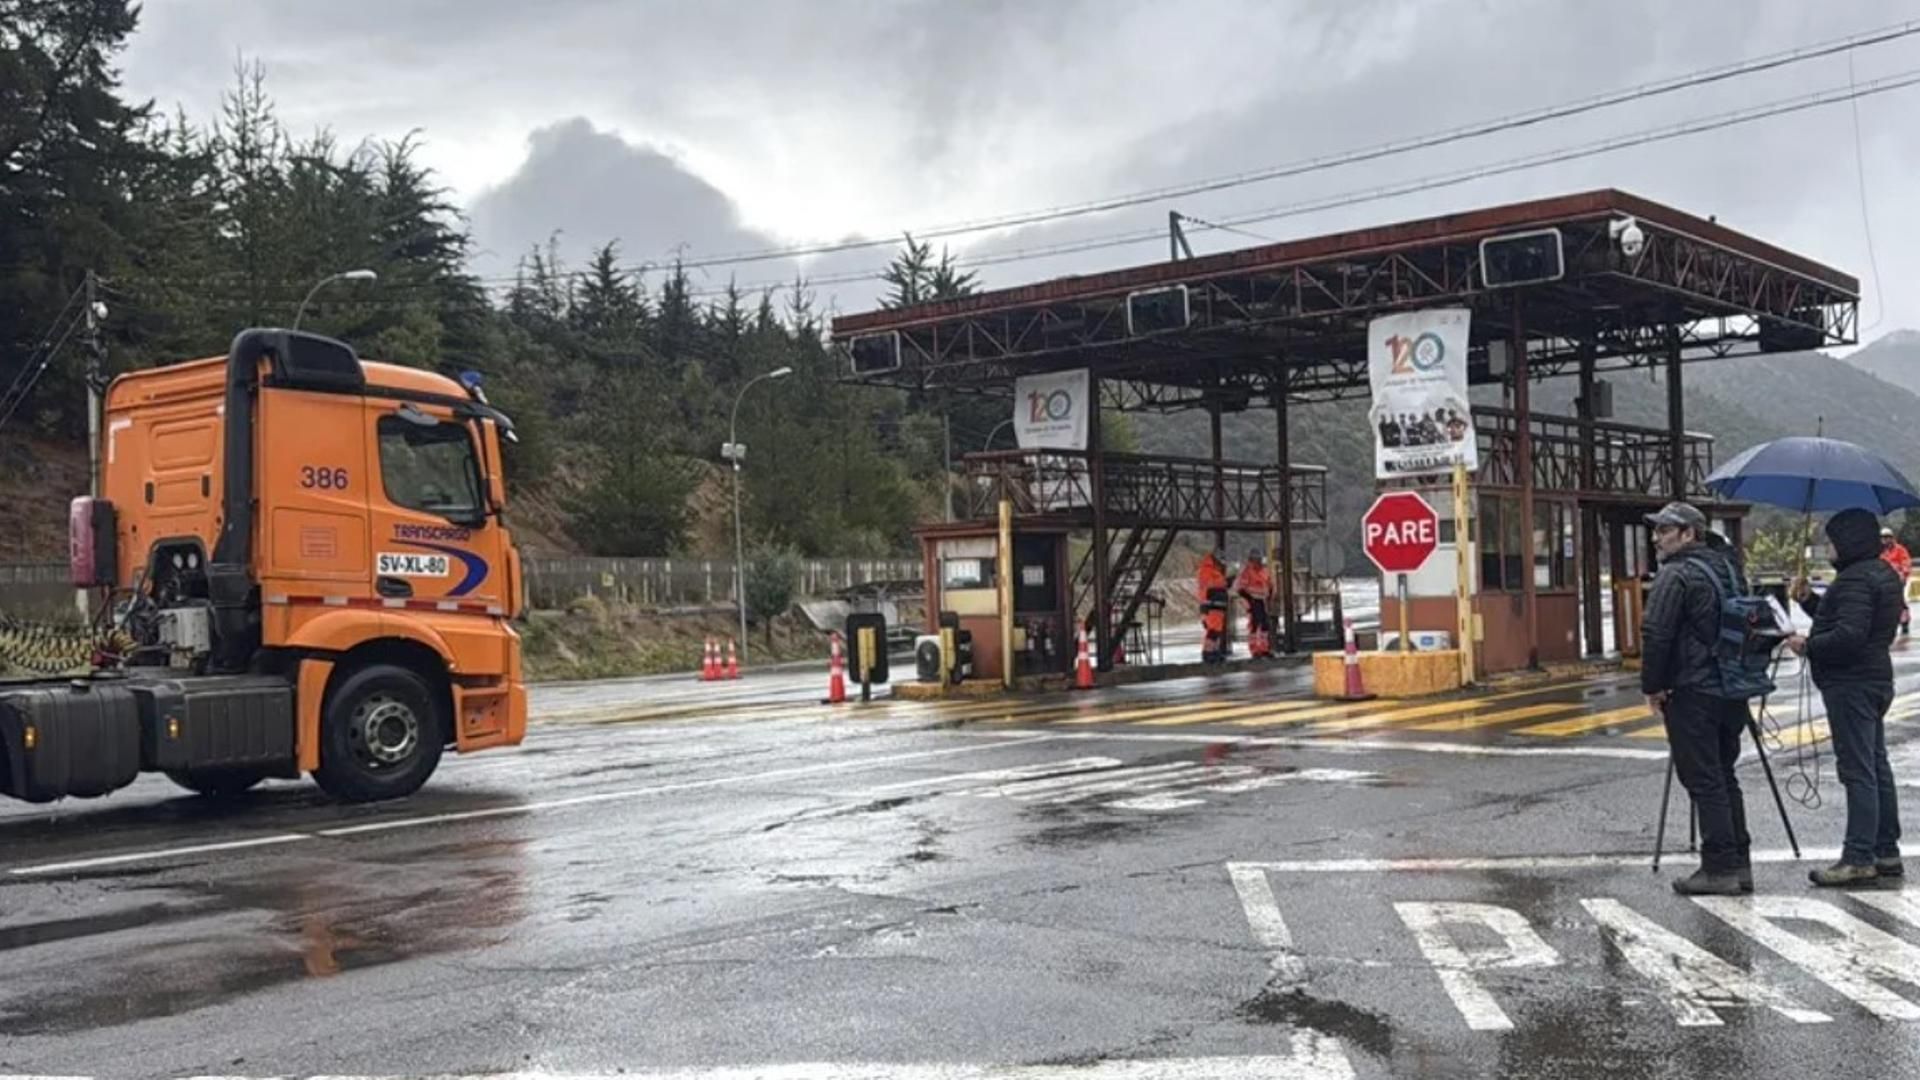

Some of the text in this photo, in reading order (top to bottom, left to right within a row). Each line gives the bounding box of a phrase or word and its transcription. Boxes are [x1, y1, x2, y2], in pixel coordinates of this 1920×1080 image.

[301, 466, 348, 489] 386
[393, 523, 472, 542] TRANSCARGO
[1367, 519, 1434, 547] PARE
[379, 555, 446, 574] SV-XL-80
[1392, 890, 1920, 1031] PAR
